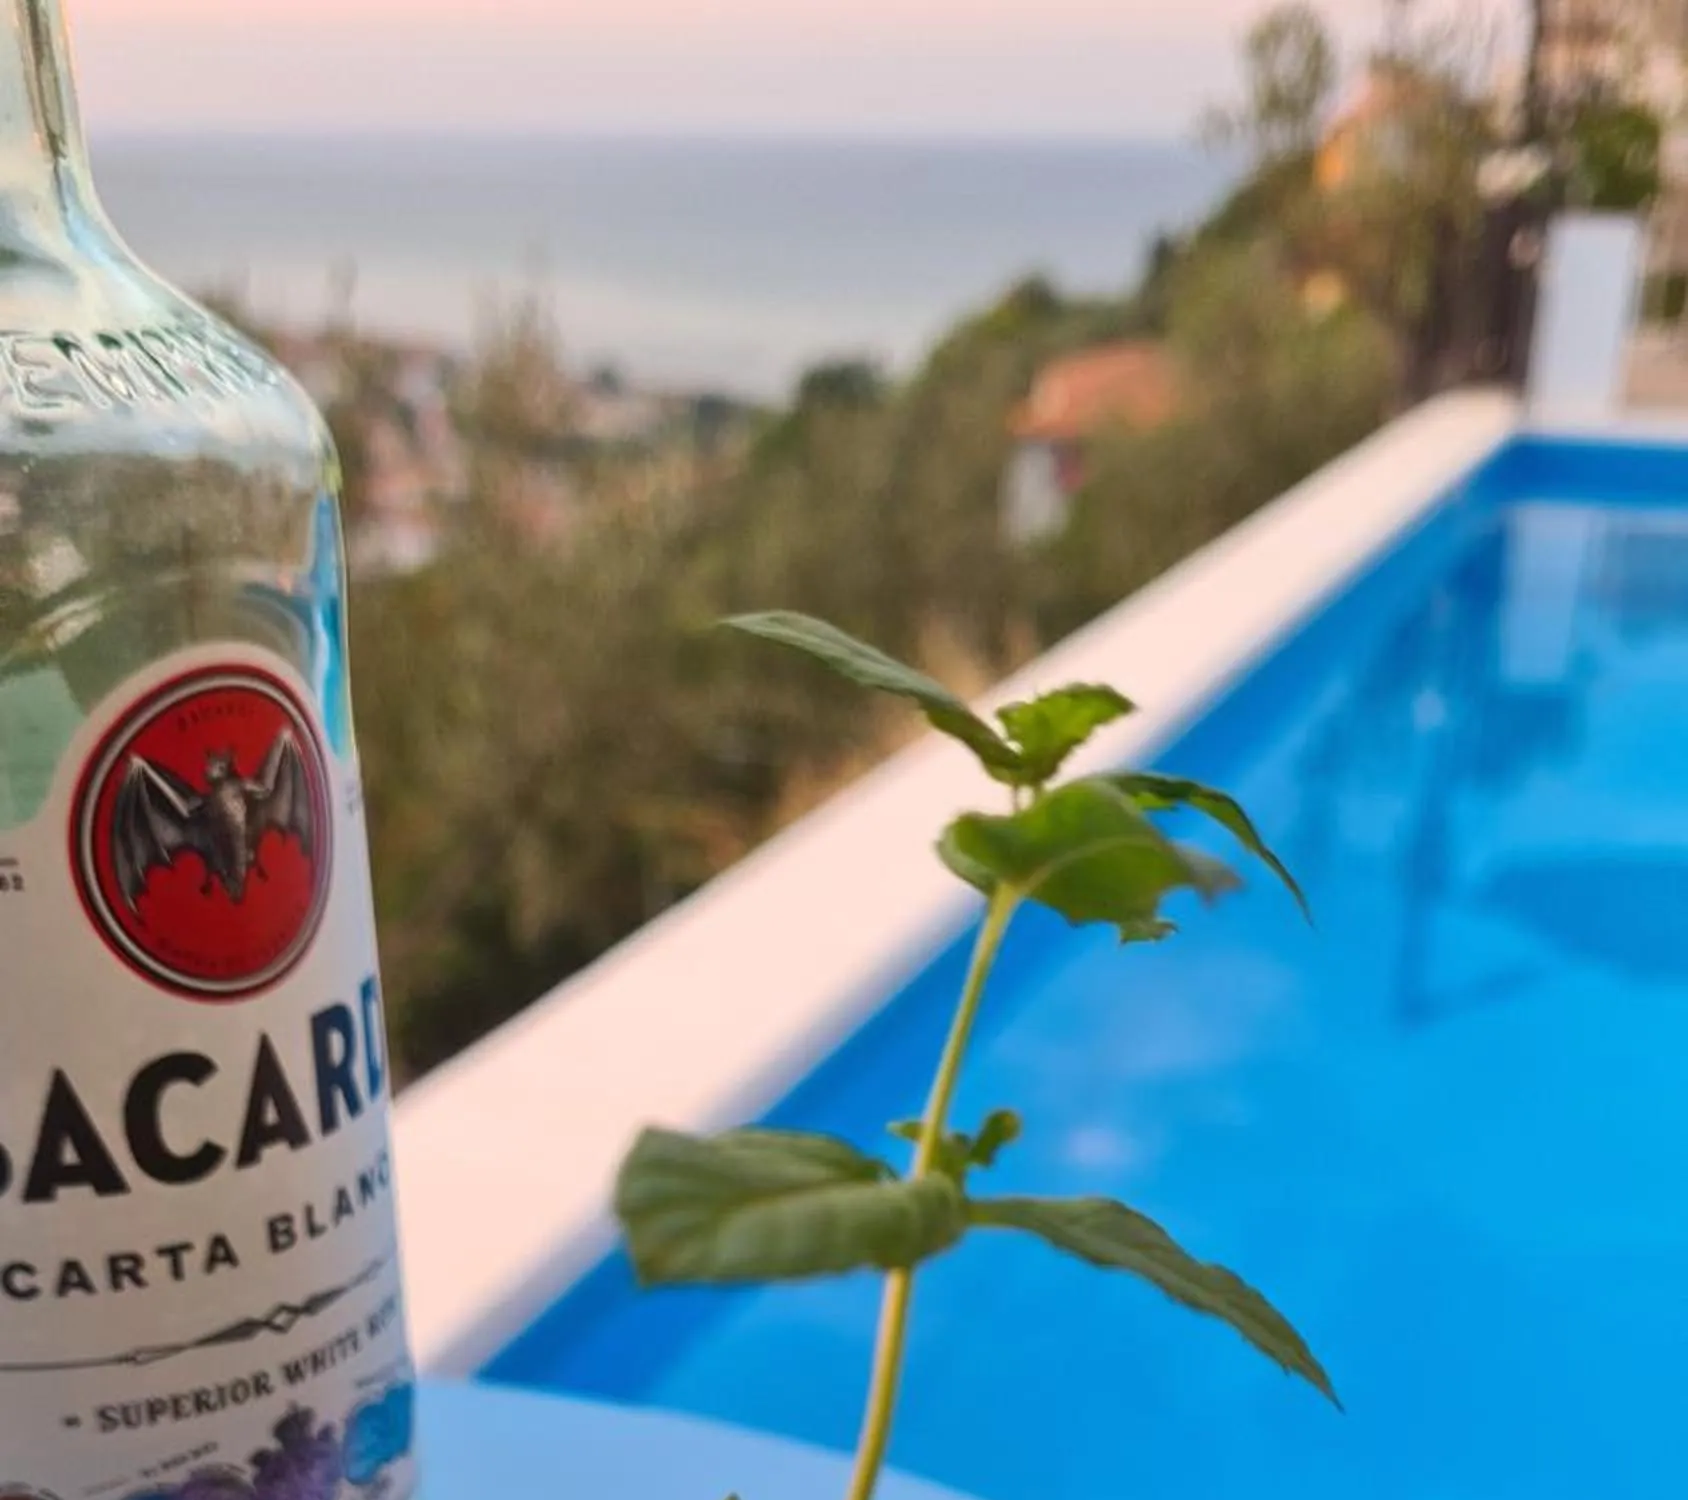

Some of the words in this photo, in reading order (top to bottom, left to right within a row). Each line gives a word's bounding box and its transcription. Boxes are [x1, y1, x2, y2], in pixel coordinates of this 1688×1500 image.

[0, 975, 385, 1203] ACARD
[1, 1234, 240, 1301] CARTA
[97, 1370, 275, 1433] SUPERIOR
